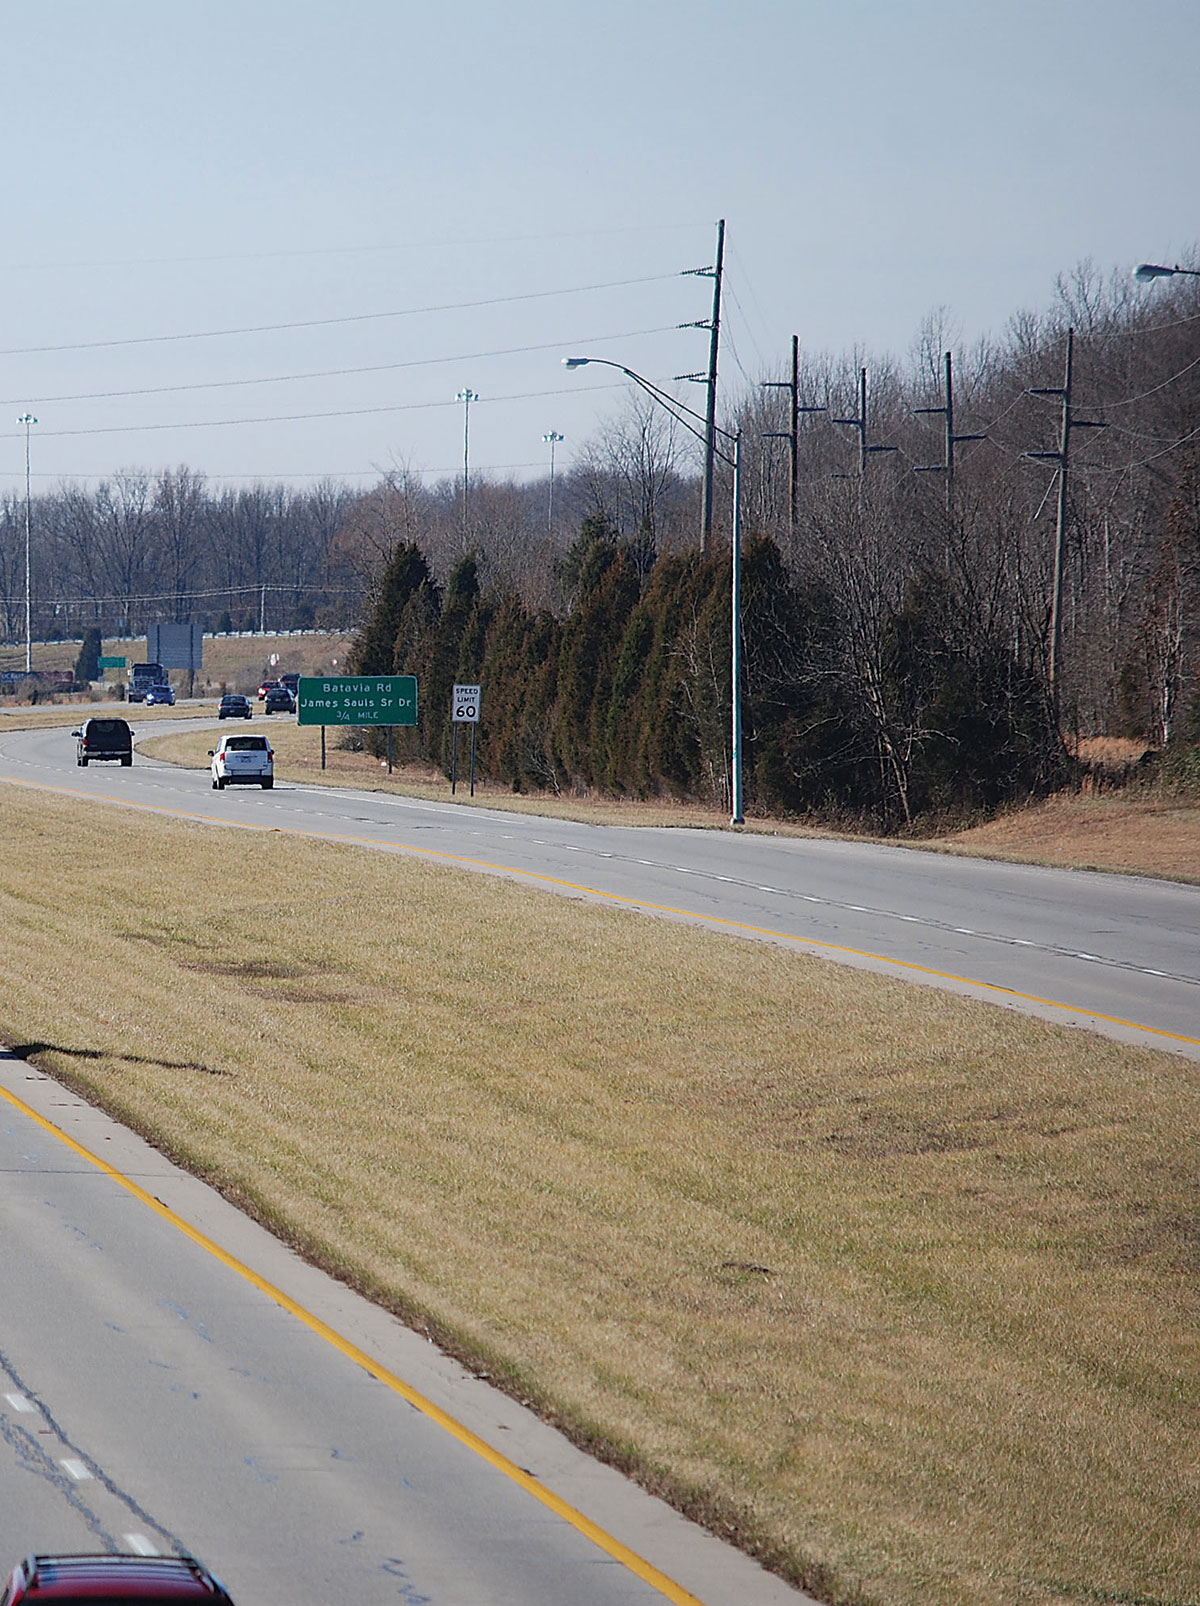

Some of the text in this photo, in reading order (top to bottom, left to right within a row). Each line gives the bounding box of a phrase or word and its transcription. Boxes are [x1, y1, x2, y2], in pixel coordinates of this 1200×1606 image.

[323, 683, 392, 692] Batavia Rd
[300, 698, 411, 708] James Sauls Sr Dr
[358, 711, 379, 719] MILE
[456, 705, 476, 717] 60
